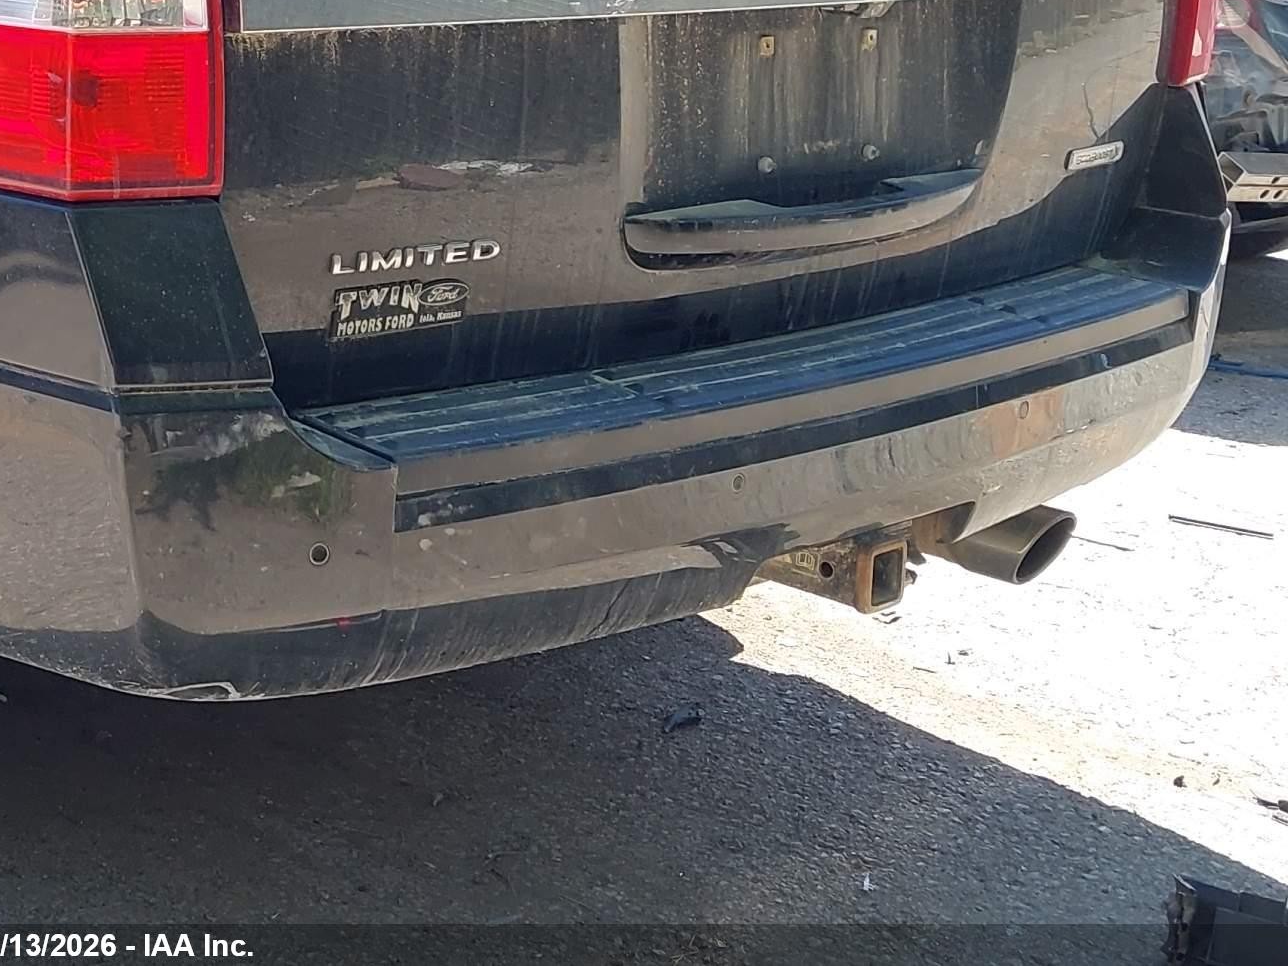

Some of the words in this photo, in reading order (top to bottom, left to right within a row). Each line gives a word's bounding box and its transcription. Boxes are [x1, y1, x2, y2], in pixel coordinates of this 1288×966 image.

[331, 238, 501, 275] LIMITED
[337, 283, 423, 321] TWIN
[426, 285, 460, 303] Ford
[336, 317, 383, 337] MOTORS
[384, 313, 415, 332] FORD
